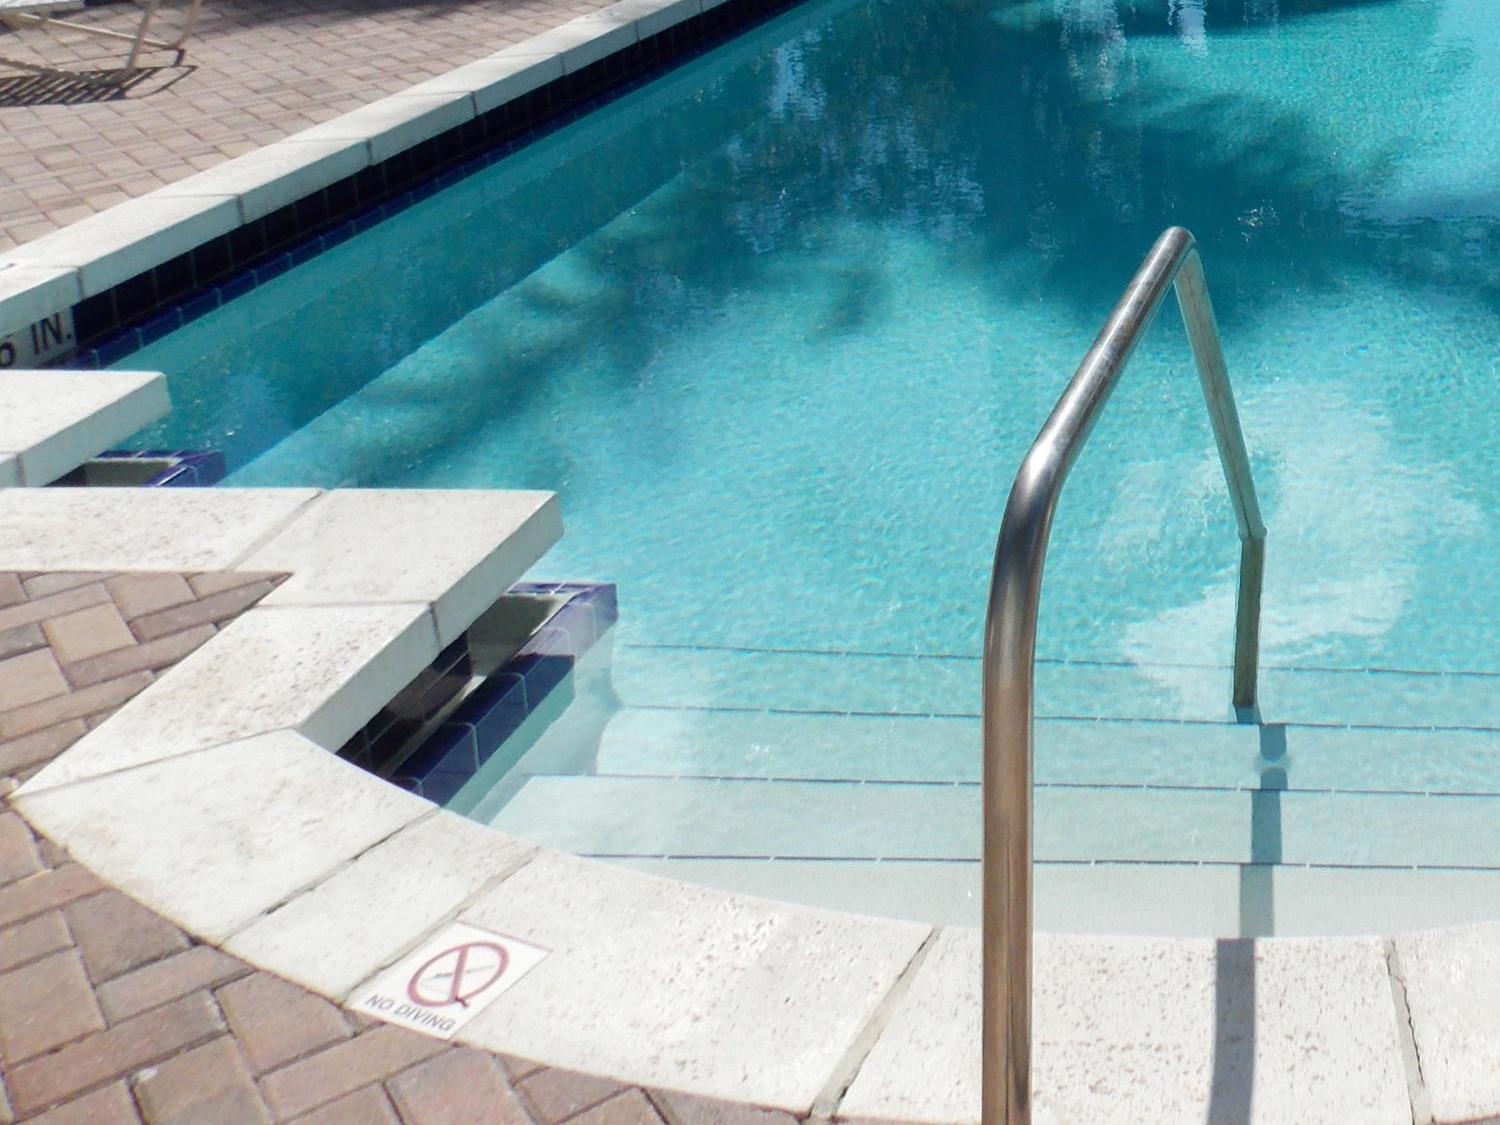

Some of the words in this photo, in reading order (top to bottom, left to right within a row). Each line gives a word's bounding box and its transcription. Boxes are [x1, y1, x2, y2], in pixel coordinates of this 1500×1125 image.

[31, 312, 72, 356] IN.
[365, 993, 392, 1011] NO
[393, 1004, 456, 1032] DIVING
